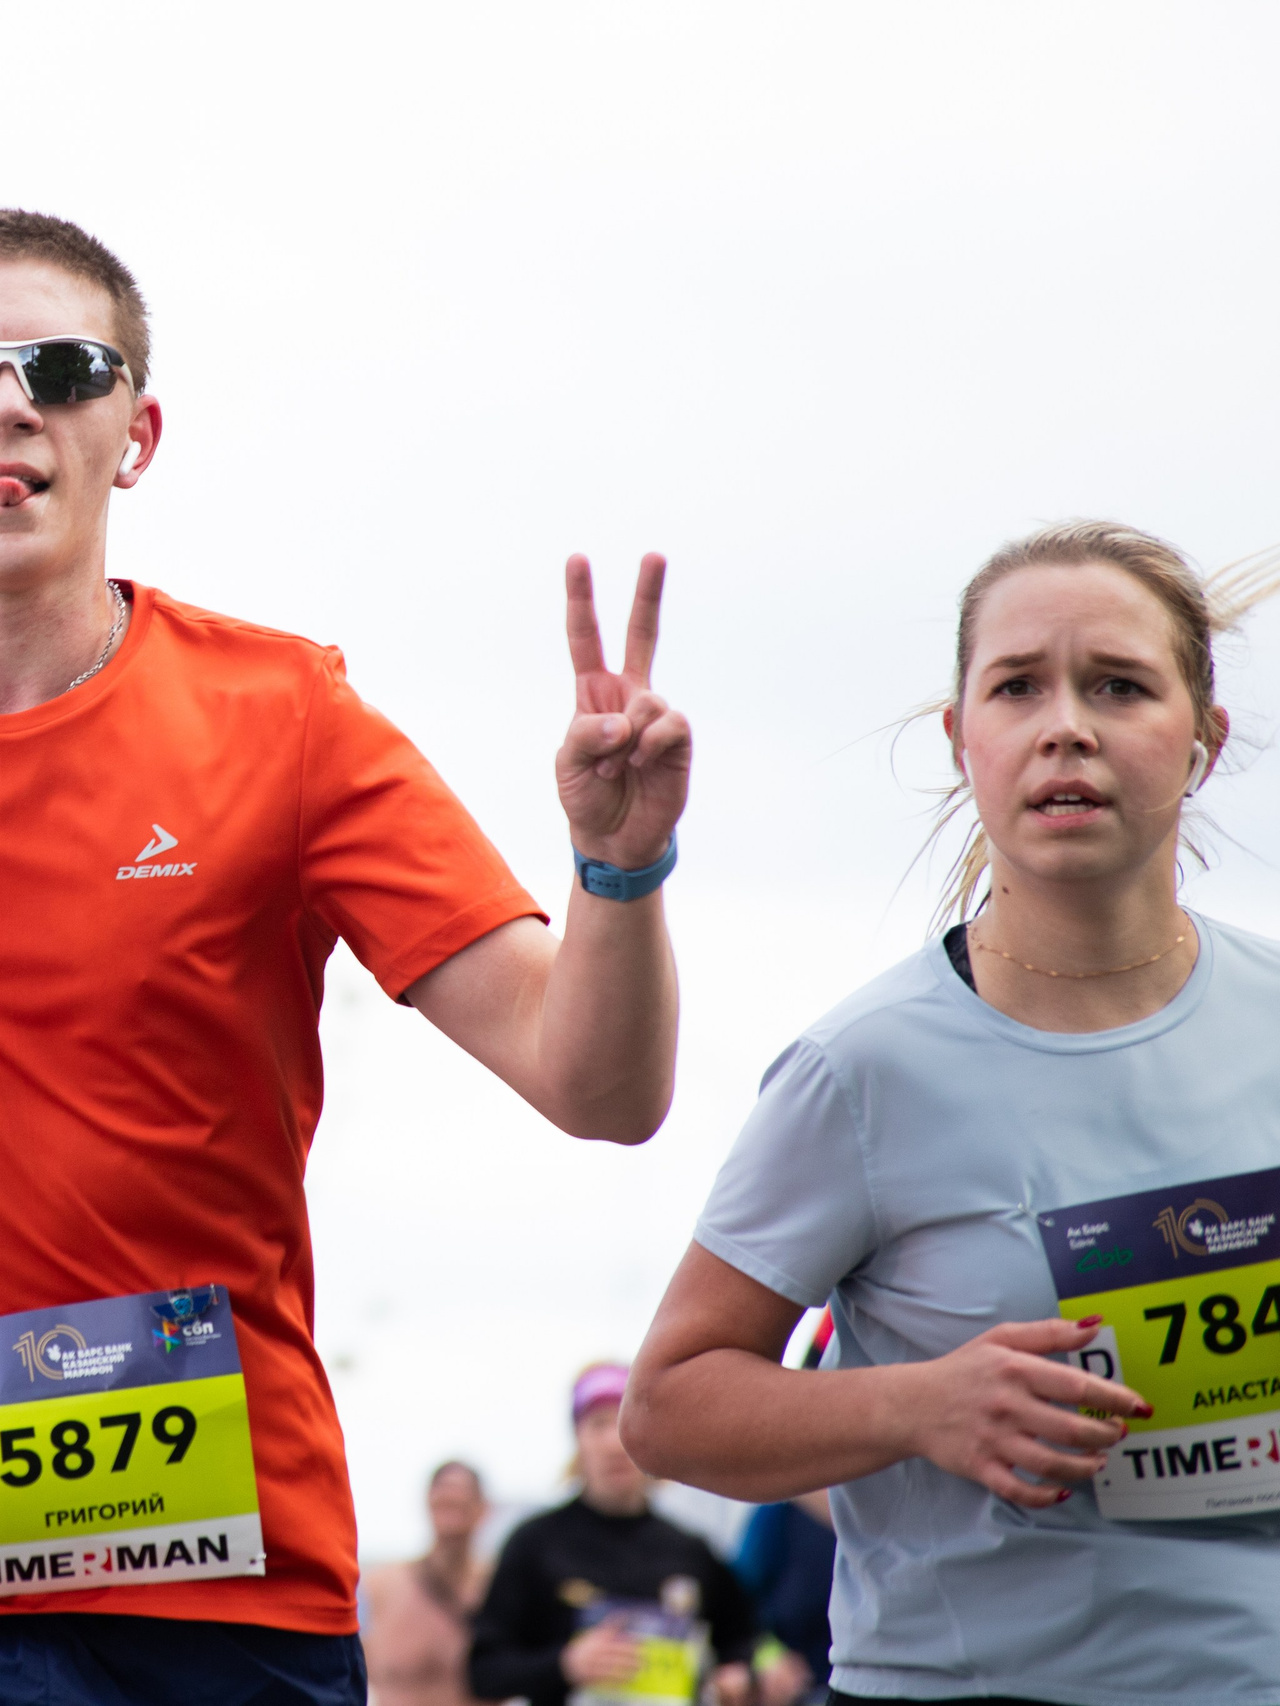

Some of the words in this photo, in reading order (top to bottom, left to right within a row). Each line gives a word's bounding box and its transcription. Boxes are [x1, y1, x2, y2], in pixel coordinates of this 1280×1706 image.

[115, 862, 198, 880] DEMIX
[1143, 1284, 1280, 1365] 784
[1192, 1375, 1280, 1410] АНАСТА
[0, 1405, 197, 1489] 5879
[1122, 1429, 1280, 1480] TIMER
[45, 1492, 166, 1529] ГРИГОРИЙ
